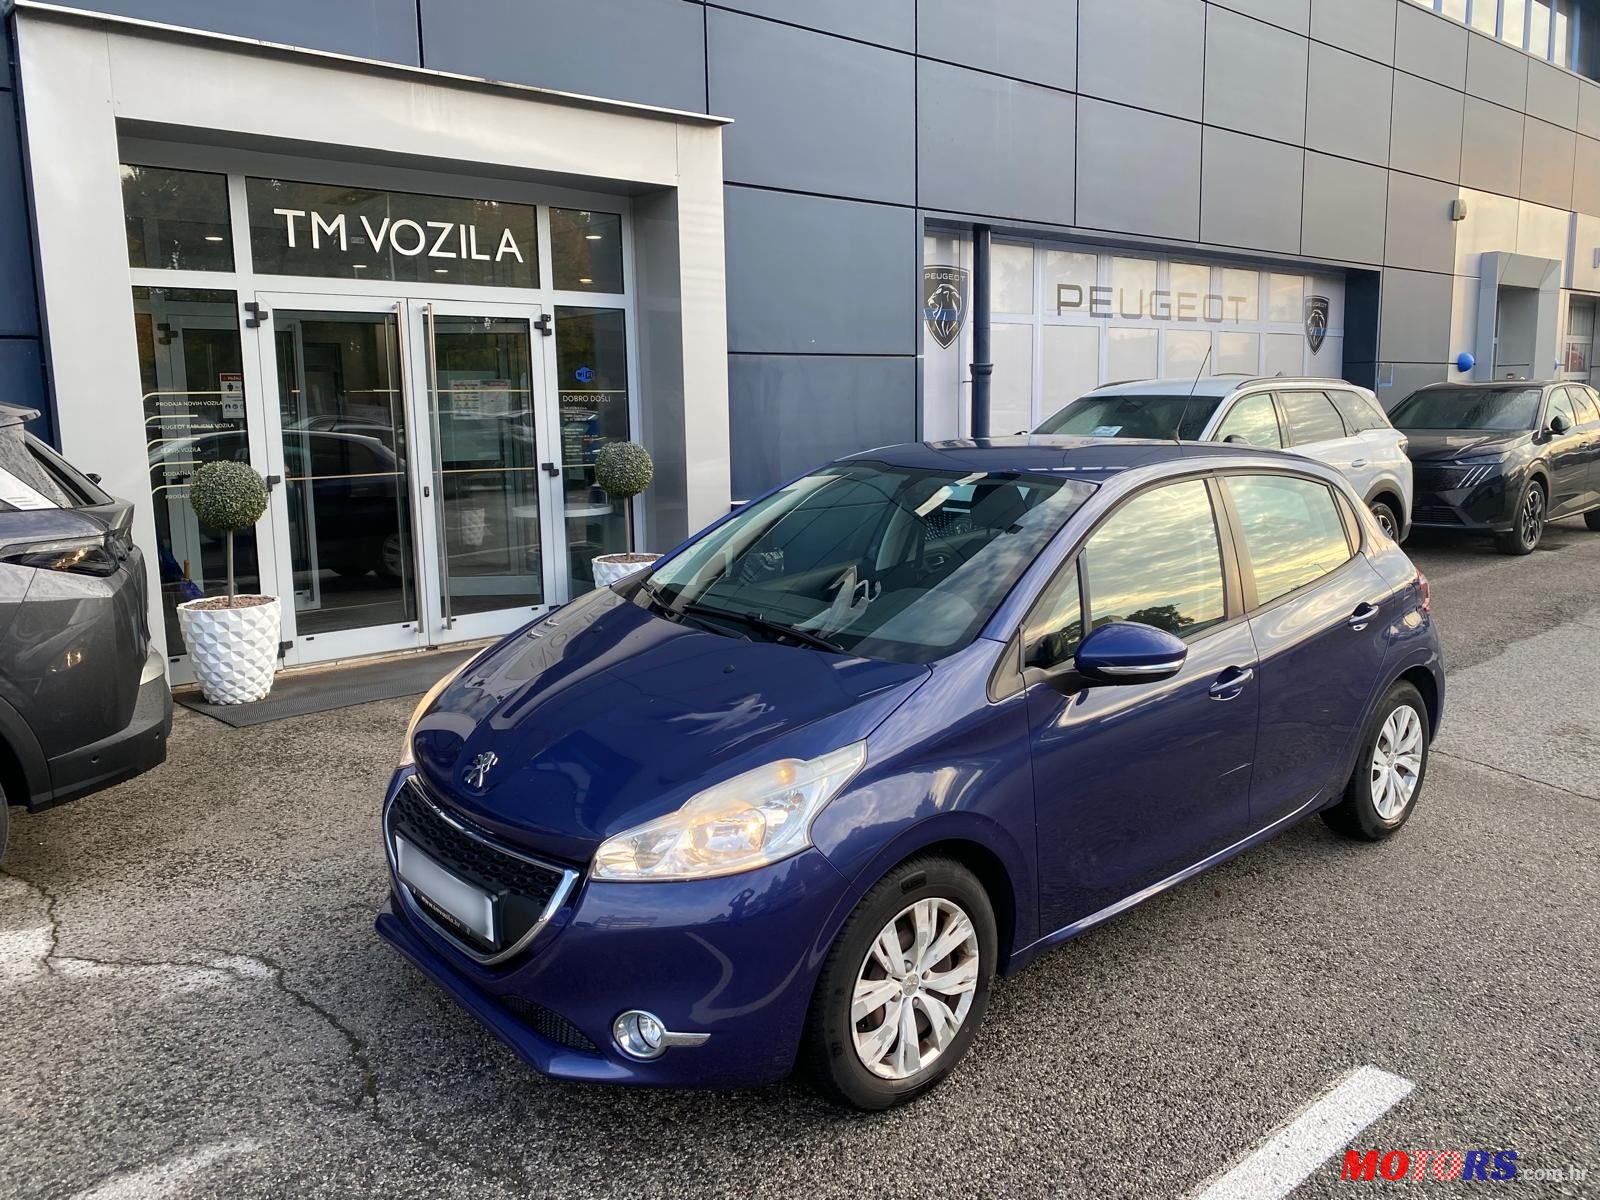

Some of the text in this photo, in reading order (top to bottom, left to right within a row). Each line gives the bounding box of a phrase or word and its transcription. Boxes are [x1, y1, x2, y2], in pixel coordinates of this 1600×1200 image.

[273, 208, 524, 263] TM VOZILA
[924, 272, 966, 281] PEUGEOT
[1057, 283, 1247, 325] PEUGEOT
[590, 393, 611, 402] DOŠLI
